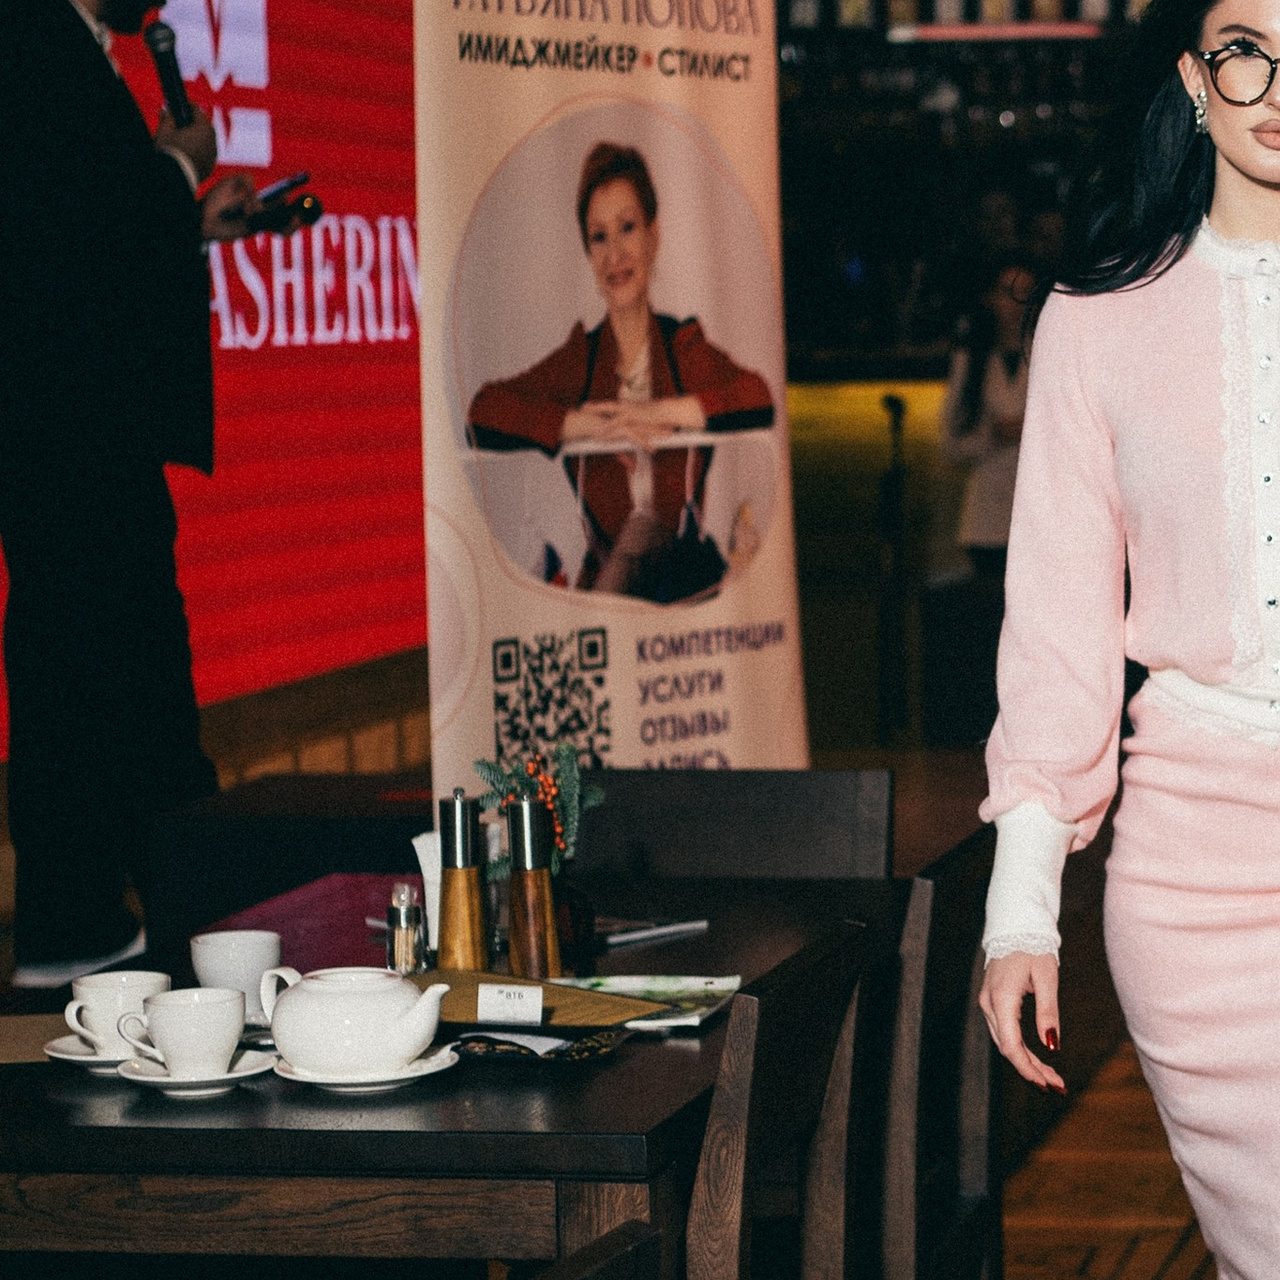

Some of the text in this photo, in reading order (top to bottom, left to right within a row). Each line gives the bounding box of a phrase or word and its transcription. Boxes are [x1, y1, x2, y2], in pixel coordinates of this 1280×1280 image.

[458, 31, 751, 82] ИМИДЖМЕЙКЕР СТИЛИСТ
[636, 622, 785, 663] КОМПЕТЕНЦИИ
[638, 669, 723, 705] УСЛУГИ
[640, 708, 730, 747] ОТЗЫВЫ
